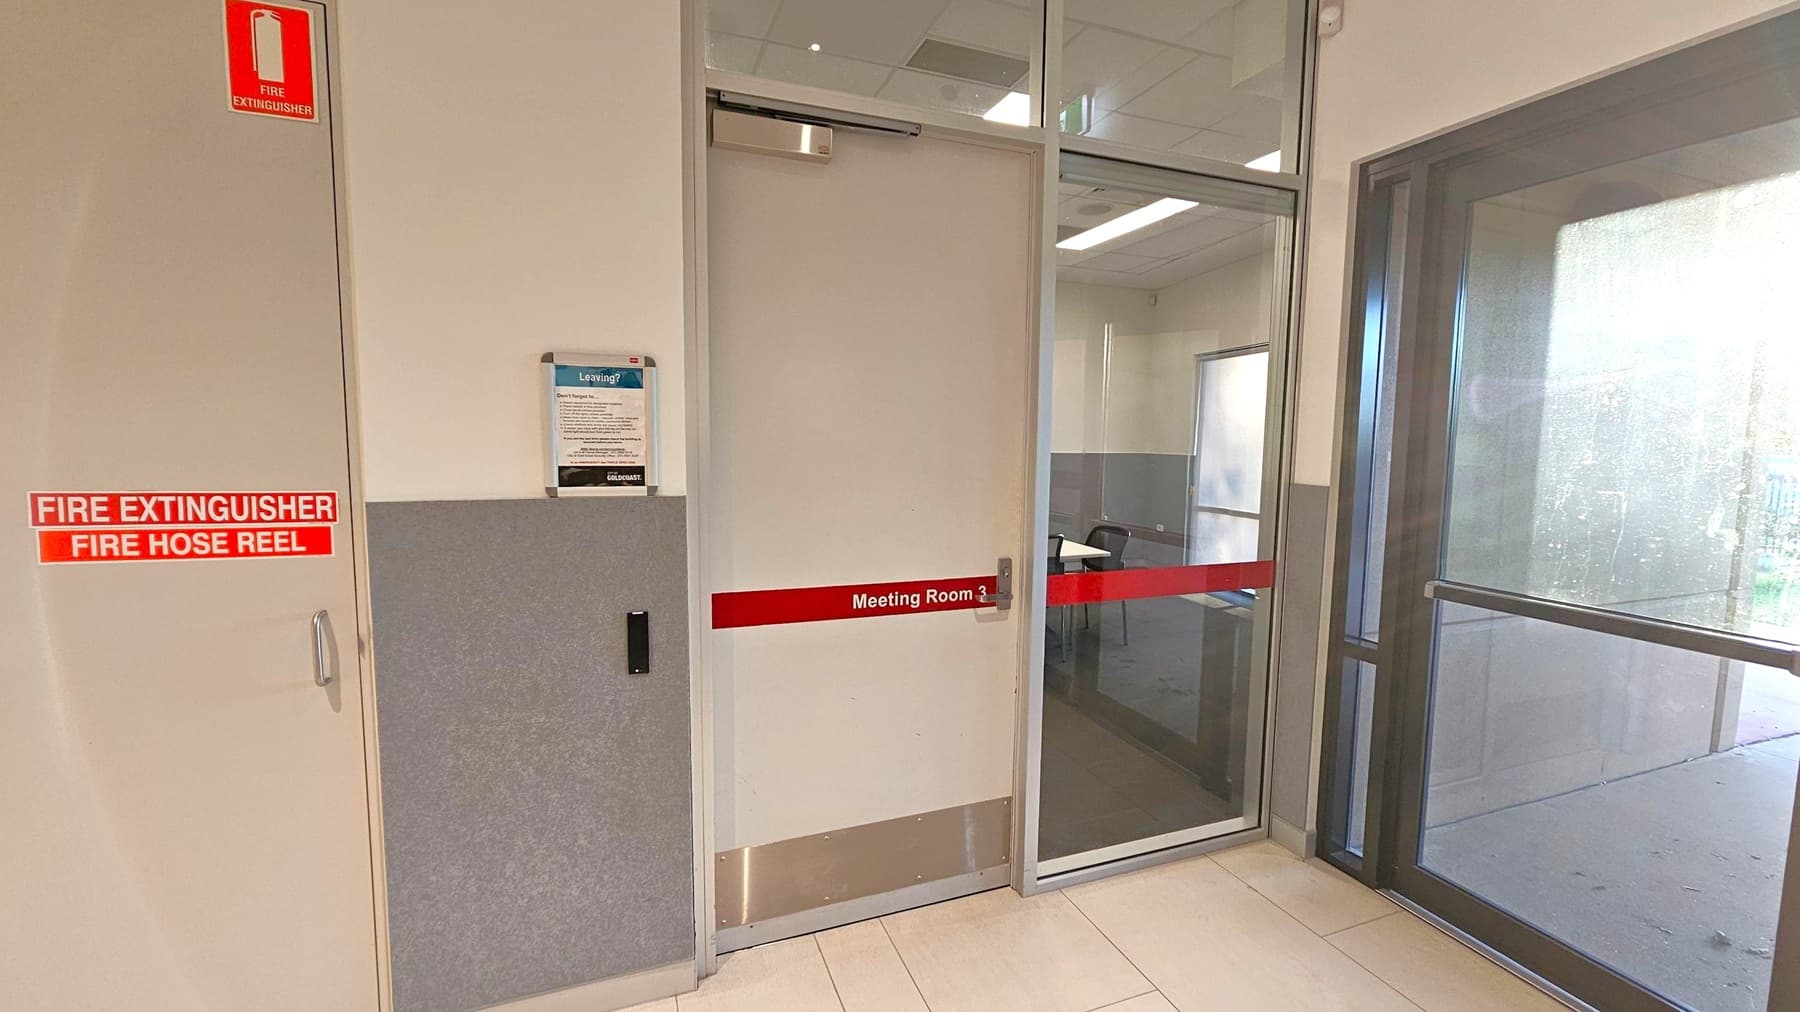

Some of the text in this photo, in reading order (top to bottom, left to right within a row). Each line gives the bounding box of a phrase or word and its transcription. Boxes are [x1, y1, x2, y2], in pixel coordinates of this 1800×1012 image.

[260, 85, 285, 97] FIRE
[233, 96, 312, 115] EXTINGUISHER
[579, 372, 621, 384] Leaving?
[38, 495, 333, 523] FIRE EXTINGUISHER
[71, 531, 306, 557] FIRE HOSE REEL
[852, 585, 987, 609] Meeting Room 3
